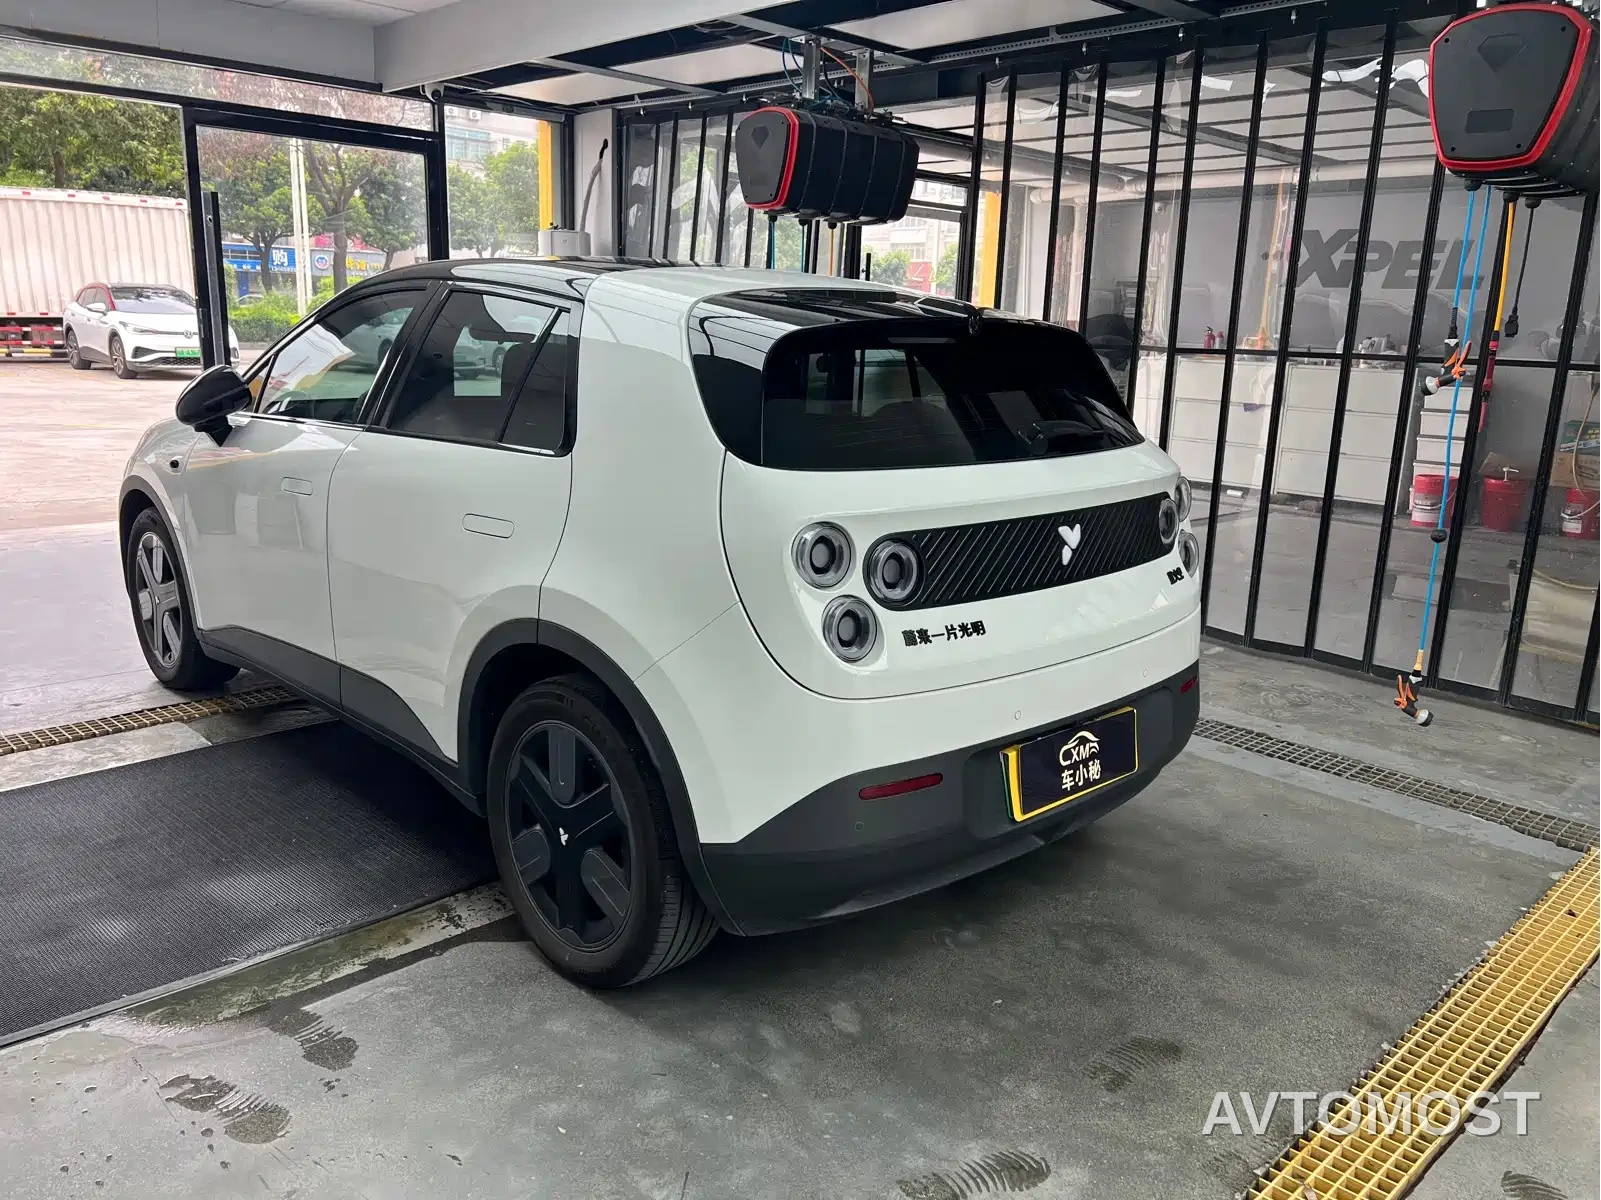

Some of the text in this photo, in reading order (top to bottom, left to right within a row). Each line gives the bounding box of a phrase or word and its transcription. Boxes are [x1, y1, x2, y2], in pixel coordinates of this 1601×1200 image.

[1280, 228, 1486, 290] XPEL
[1061, 758, 1102, 792] 车小秘
